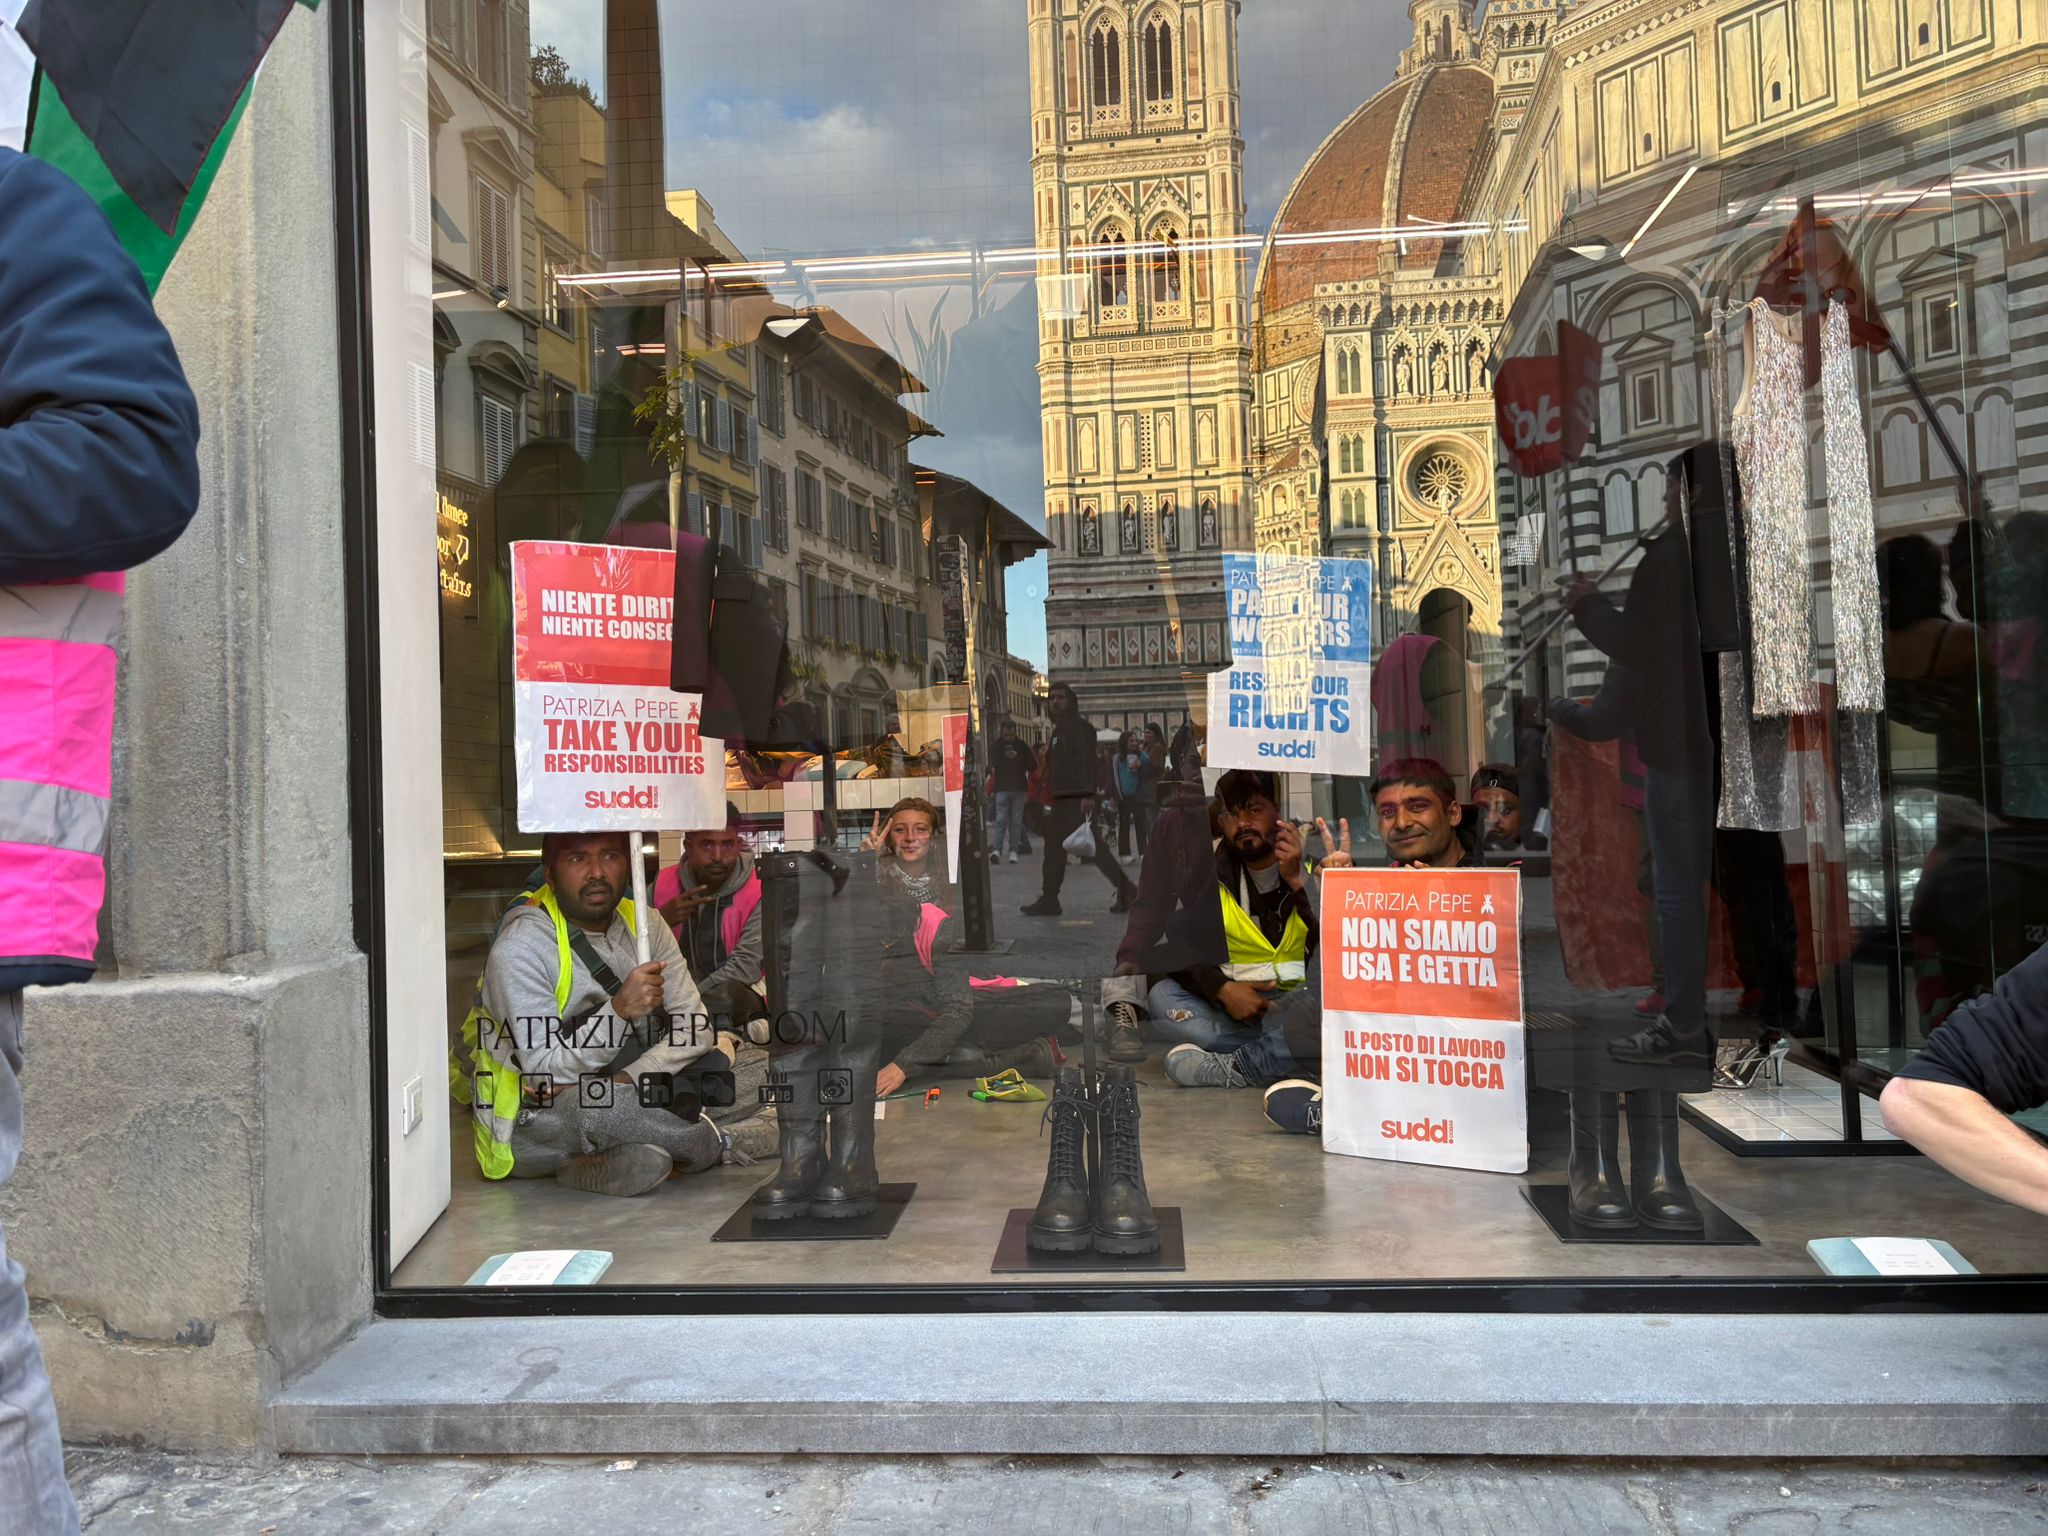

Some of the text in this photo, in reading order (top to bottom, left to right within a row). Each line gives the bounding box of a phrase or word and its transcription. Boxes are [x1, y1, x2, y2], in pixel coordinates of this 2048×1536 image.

[541, 589, 617, 616] NIENTE
[542, 616, 604, 638] NIENTE
[543, 694, 679, 719] PATRIZIA PEPE
[543, 718, 703, 753] TAKE YOUR
[544, 753, 705, 775] RESPONSIBILITIES
[1345, 890, 1472, 913] PATRIZIA PEPE
[1341, 917, 1497, 954] NON SIAMO
[1341, 951, 1497, 987] USA E GETTA
[1344, 1030, 1506, 1059] IL POSTO DI LAVORO
[1345, 1053, 1505, 1090] NON SI TOCCA
